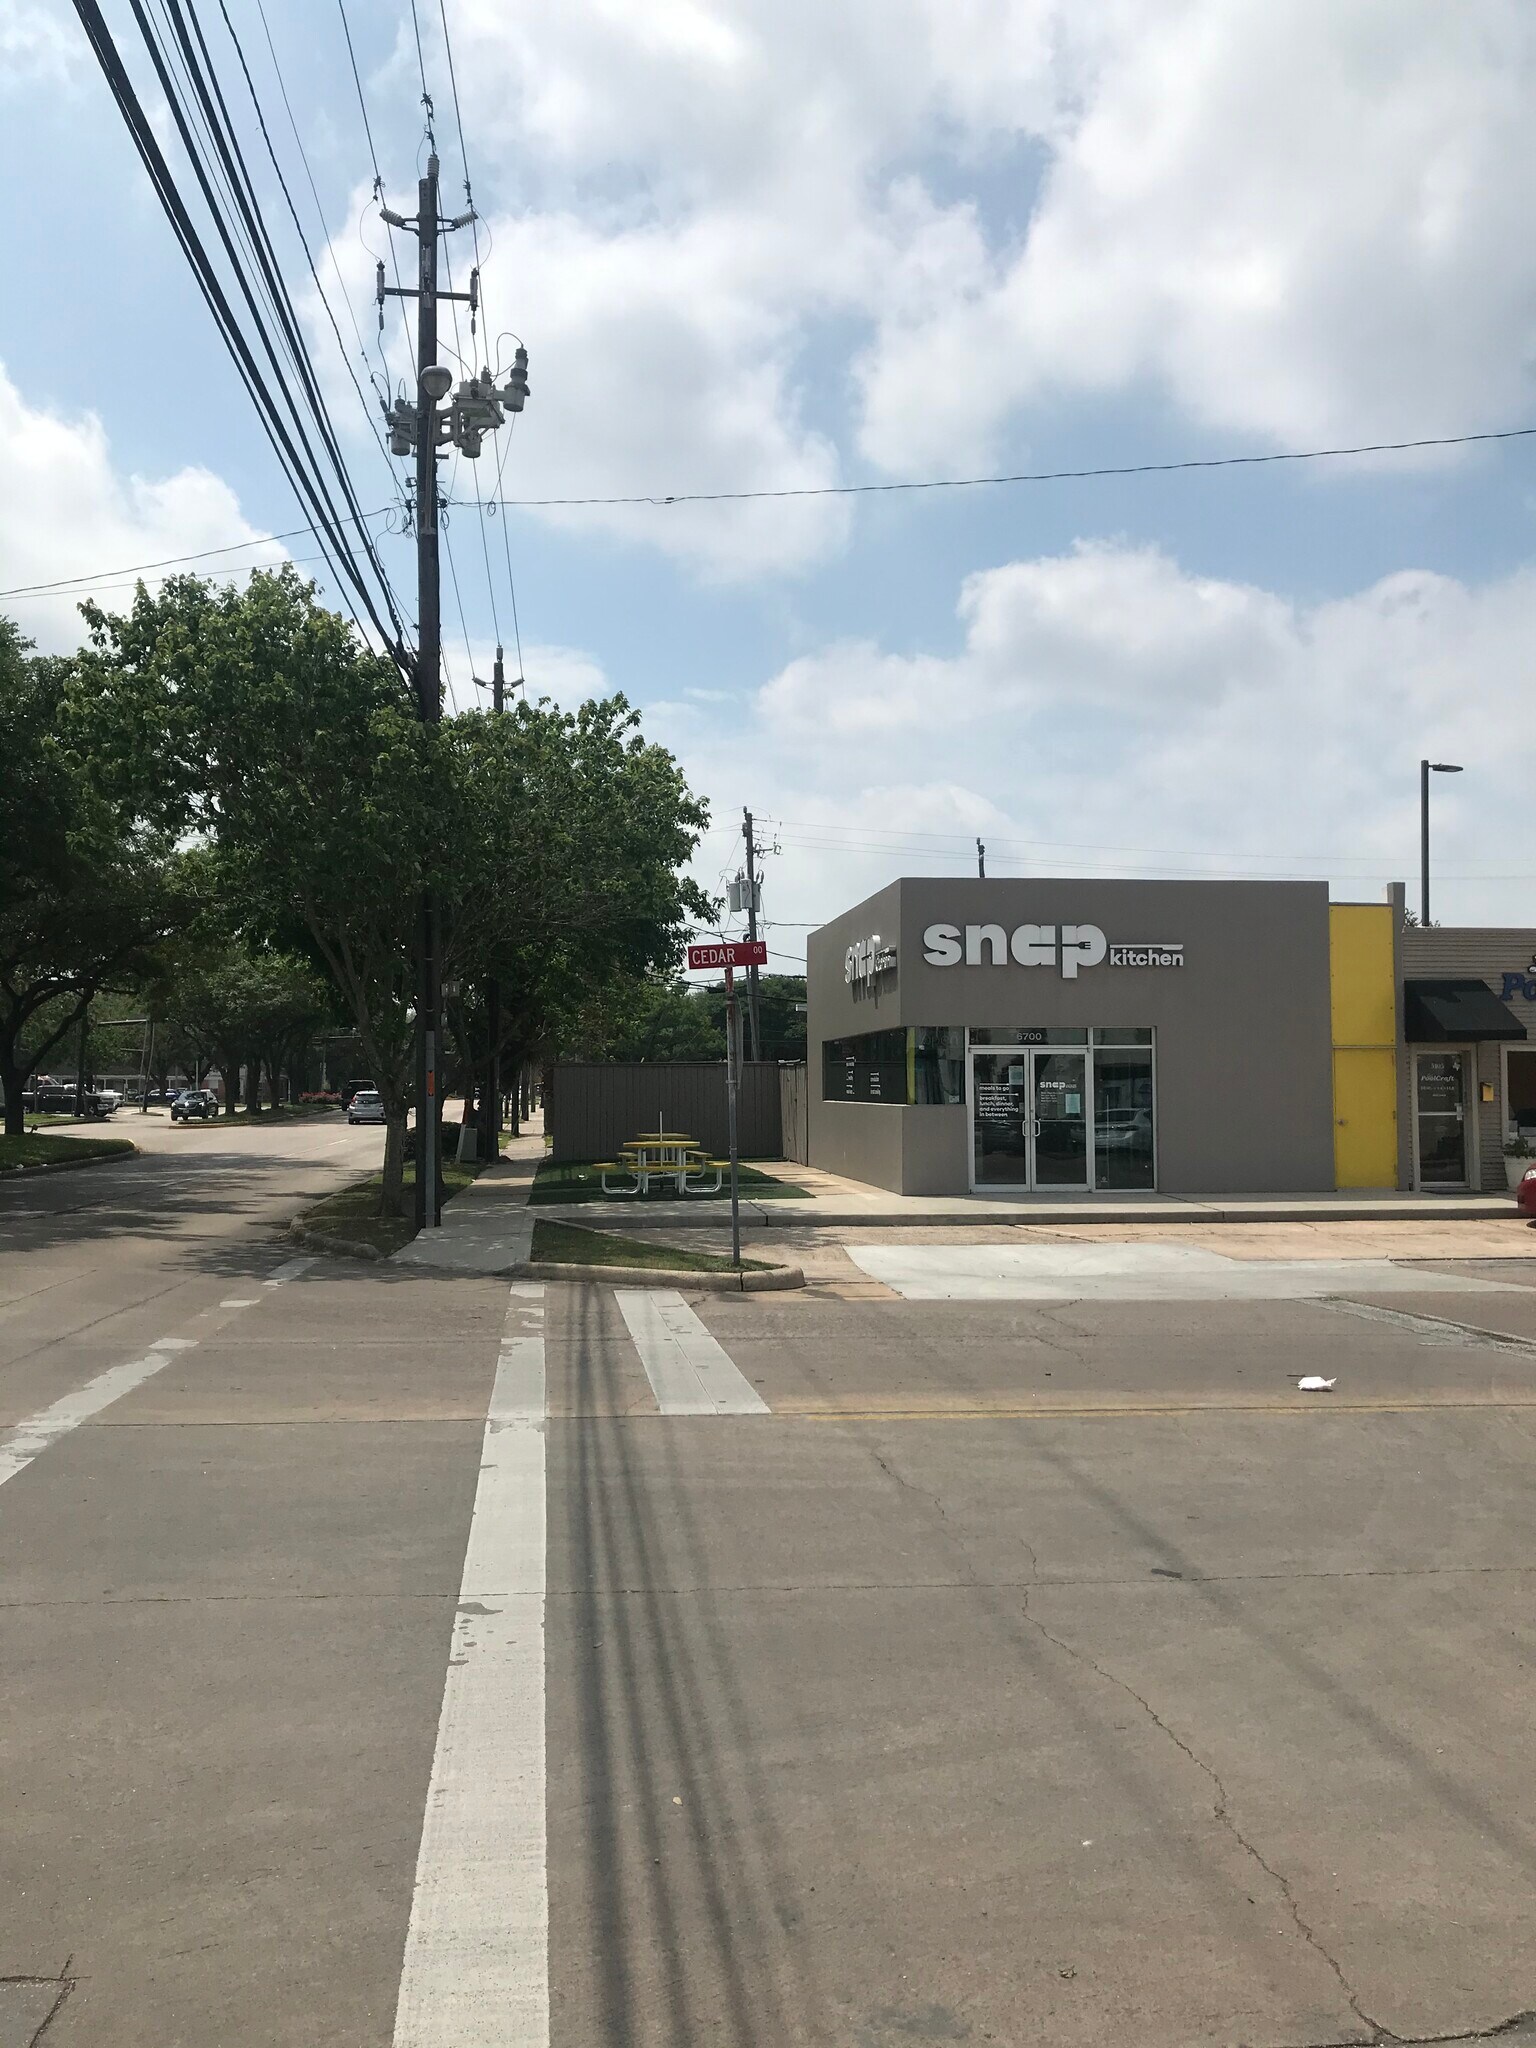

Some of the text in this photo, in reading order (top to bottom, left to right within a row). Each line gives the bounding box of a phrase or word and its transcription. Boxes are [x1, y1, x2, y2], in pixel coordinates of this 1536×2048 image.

[692, 948, 735, 965] CEDAR
[923, 923, 1107, 979] snap
[1109, 948, 1184, 966] kitchen
[1016, 1032, 1042, 1041] 6700
[1040, 1081, 1066, 1090] snap
